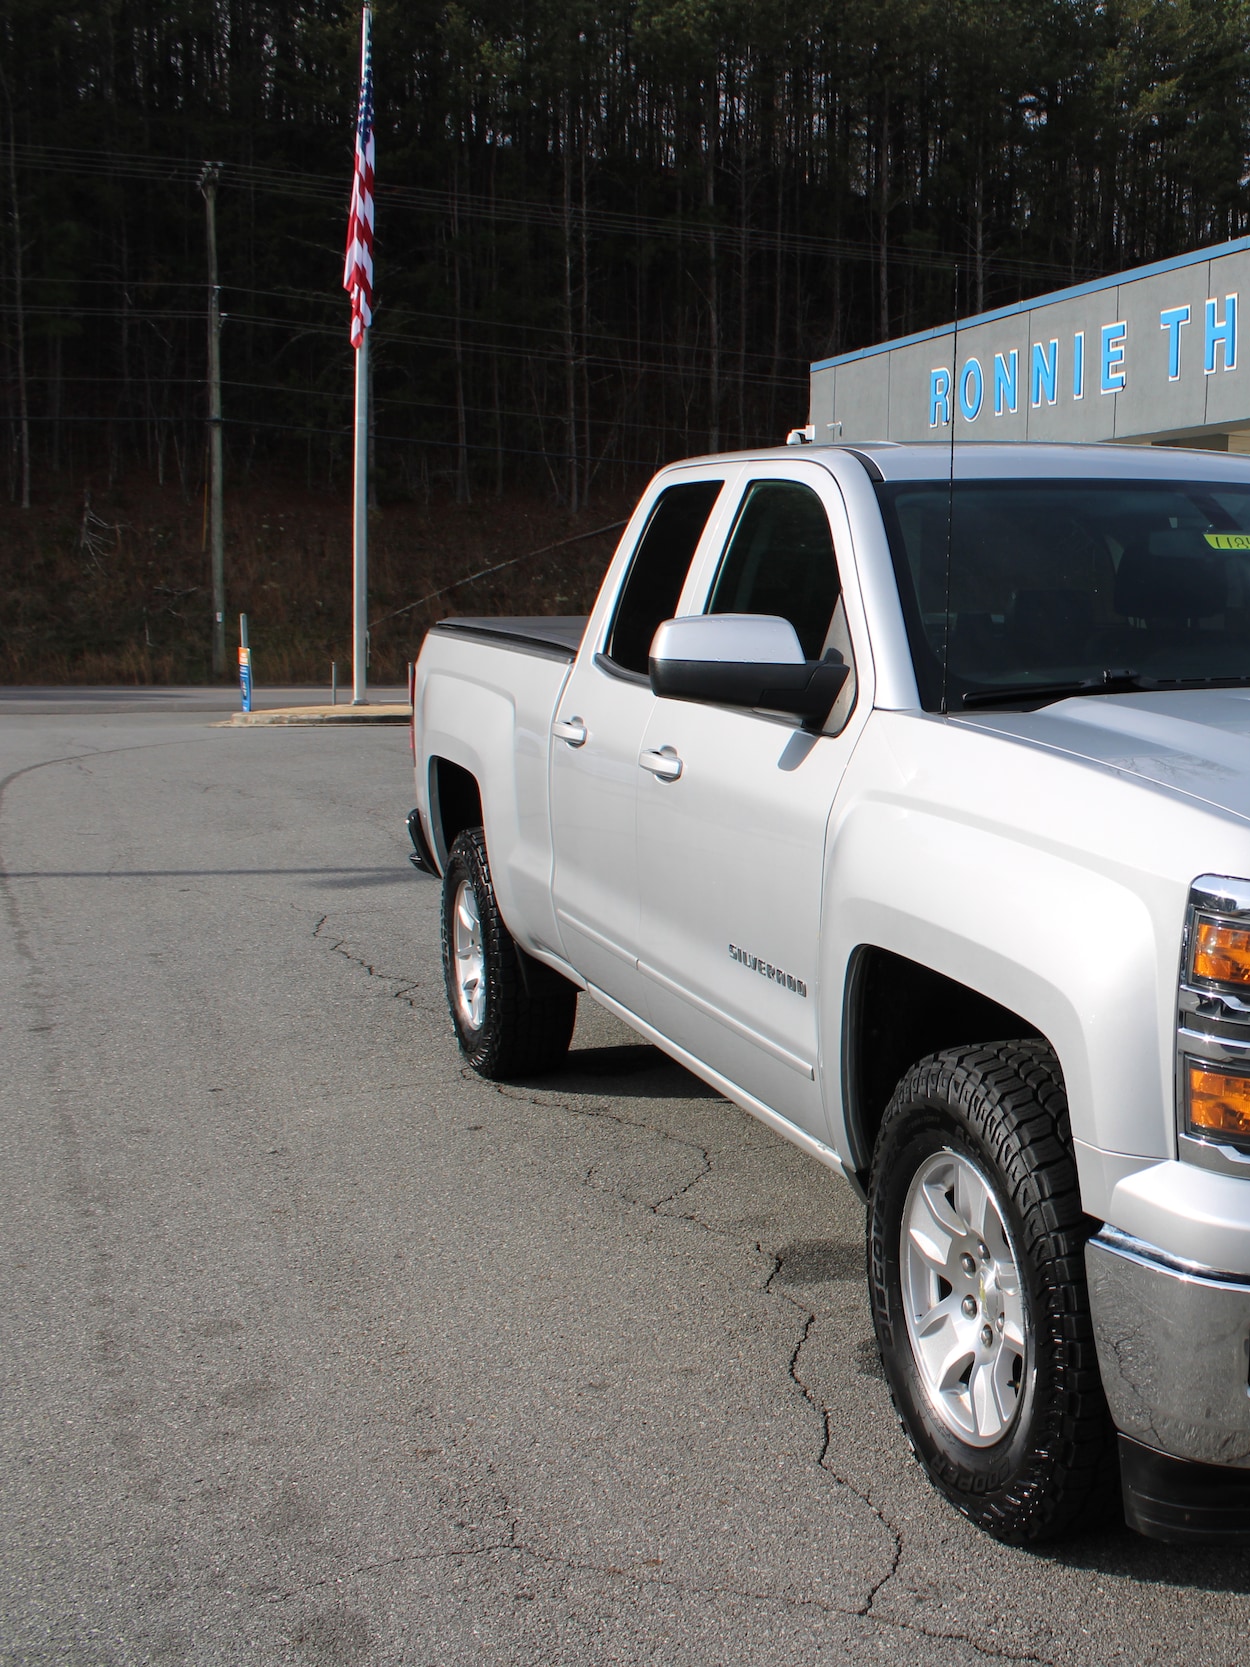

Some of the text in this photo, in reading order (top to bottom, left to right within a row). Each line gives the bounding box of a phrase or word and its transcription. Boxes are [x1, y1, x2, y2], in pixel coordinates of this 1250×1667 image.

[929, 320, 1127, 429] RONNIE
[728, 943, 807, 998] SILVERADO
[929, 1455, 1010, 1494] COOPER
